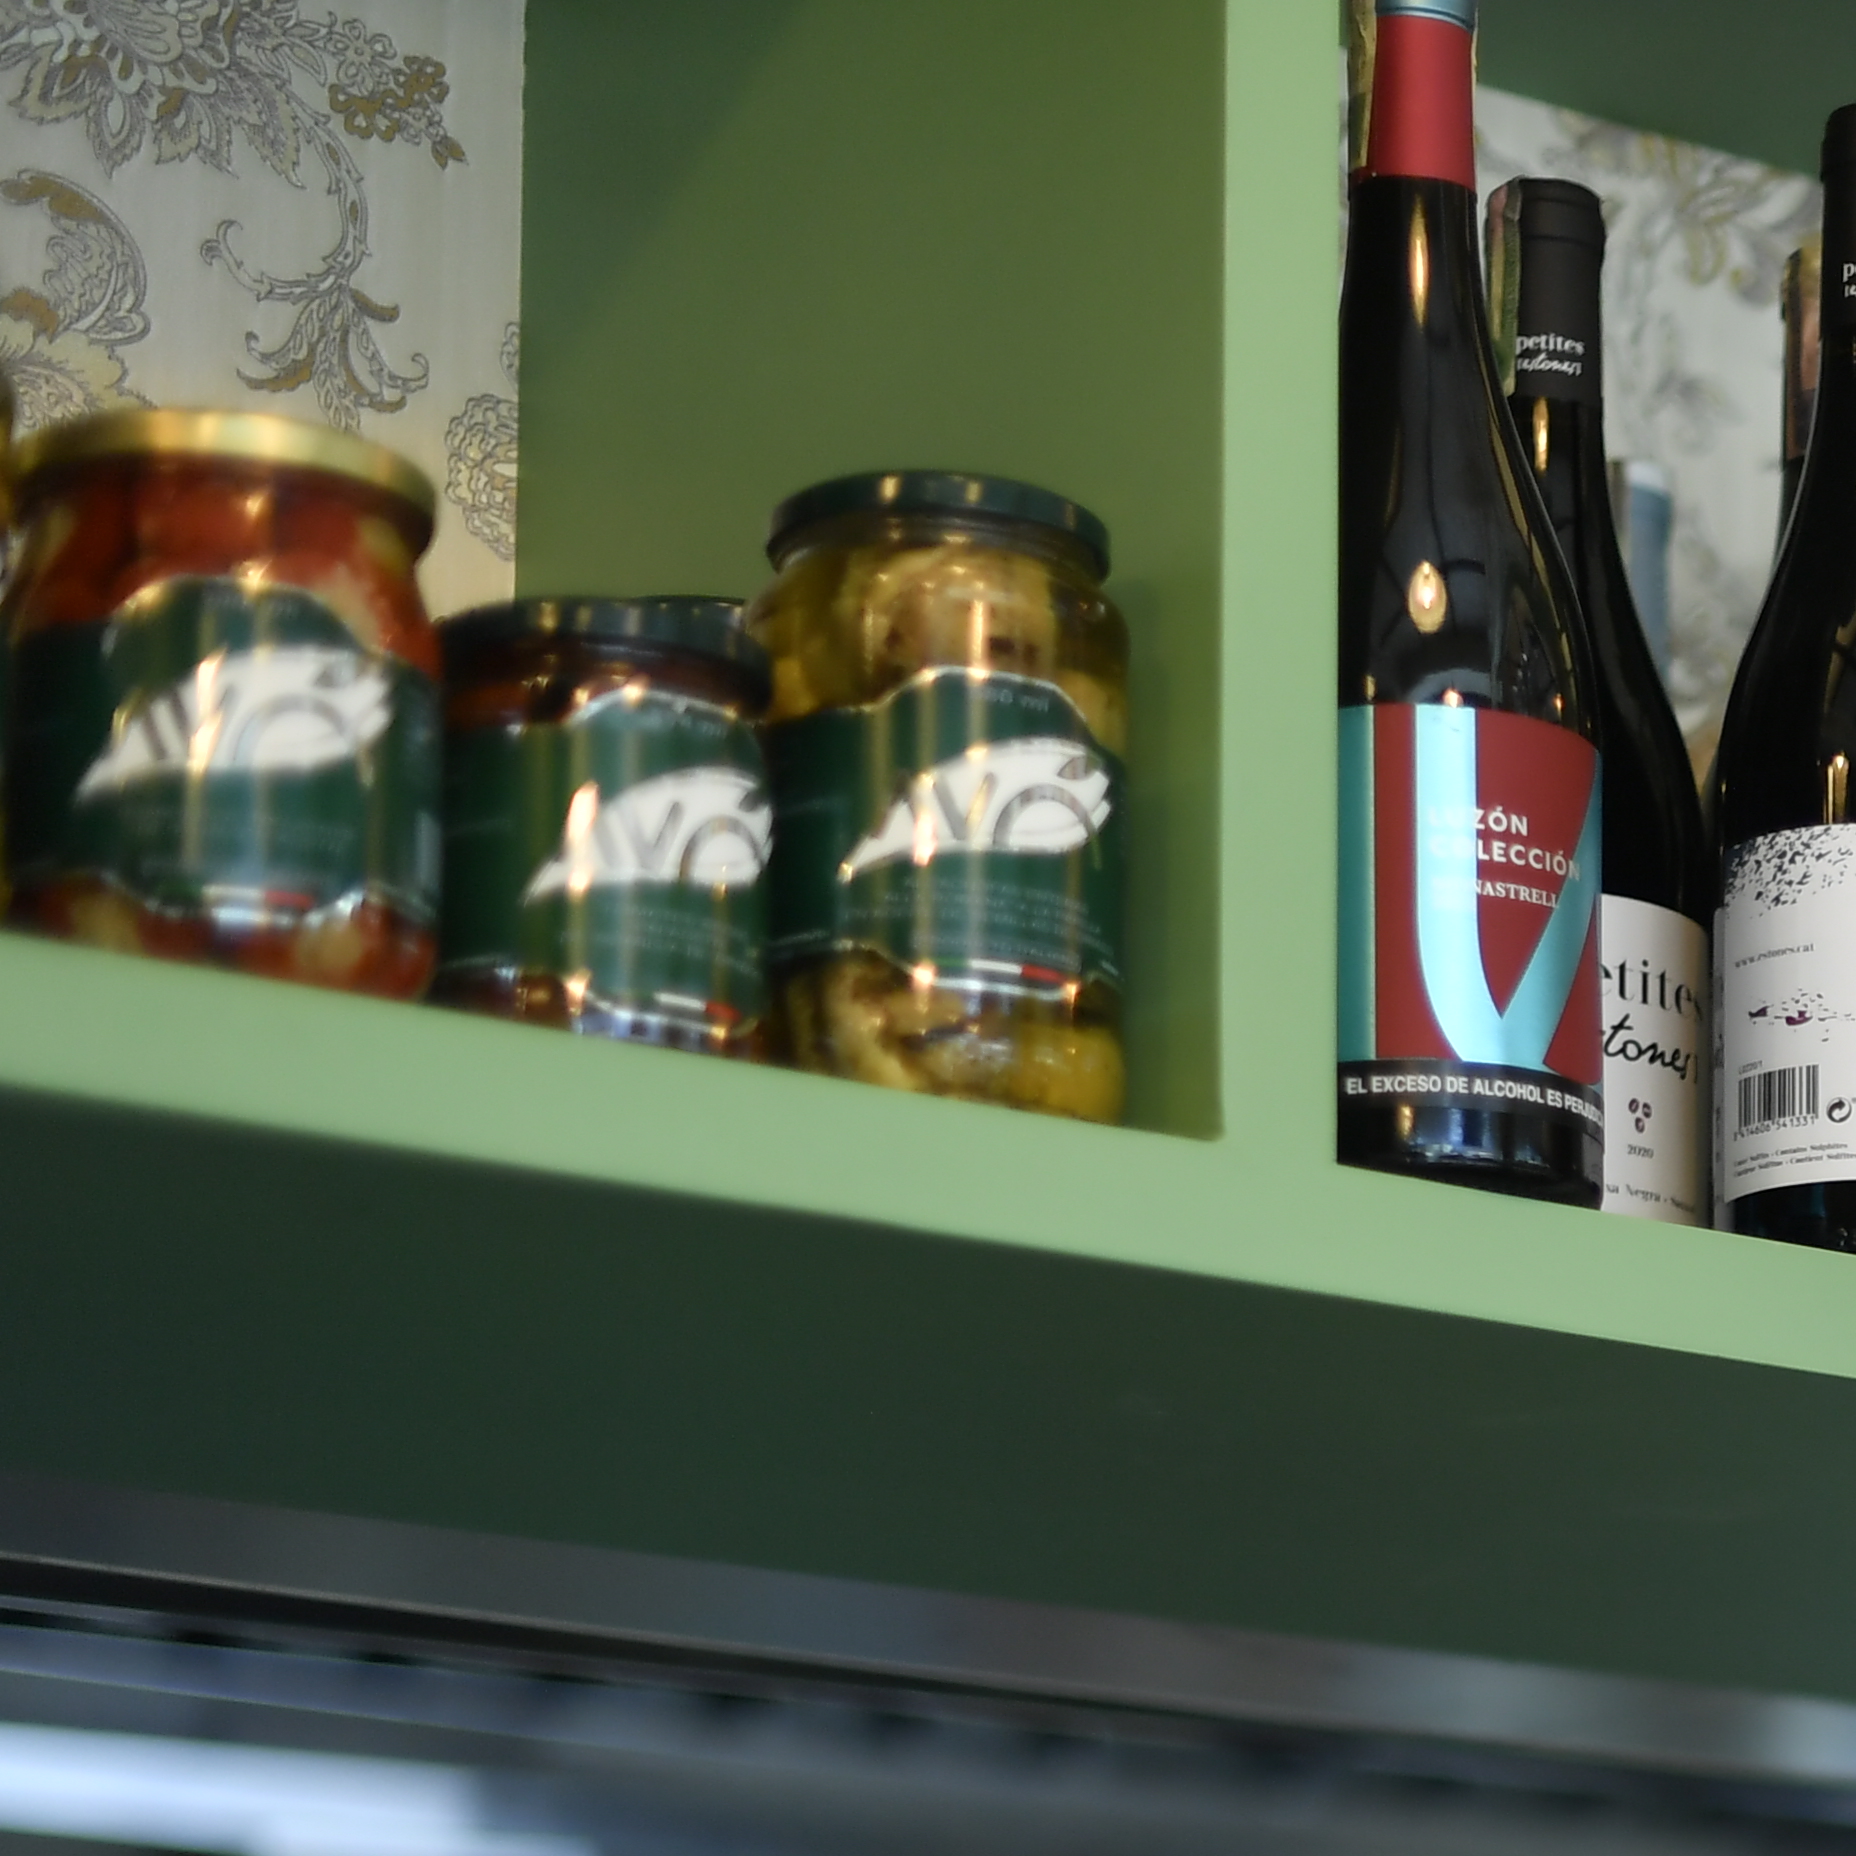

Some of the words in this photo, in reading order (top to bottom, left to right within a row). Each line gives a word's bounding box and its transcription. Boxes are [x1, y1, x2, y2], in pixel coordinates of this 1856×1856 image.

[1347, 1077, 1368, 1095] EL
[1371, 1074, 1442, 1094] EXCESO
[1446, 1076, 1469, 1094] DE
[1473, 1078, 1545, 1105] ALCOHOL
[1547, 1087, 1563, 1108] ES
